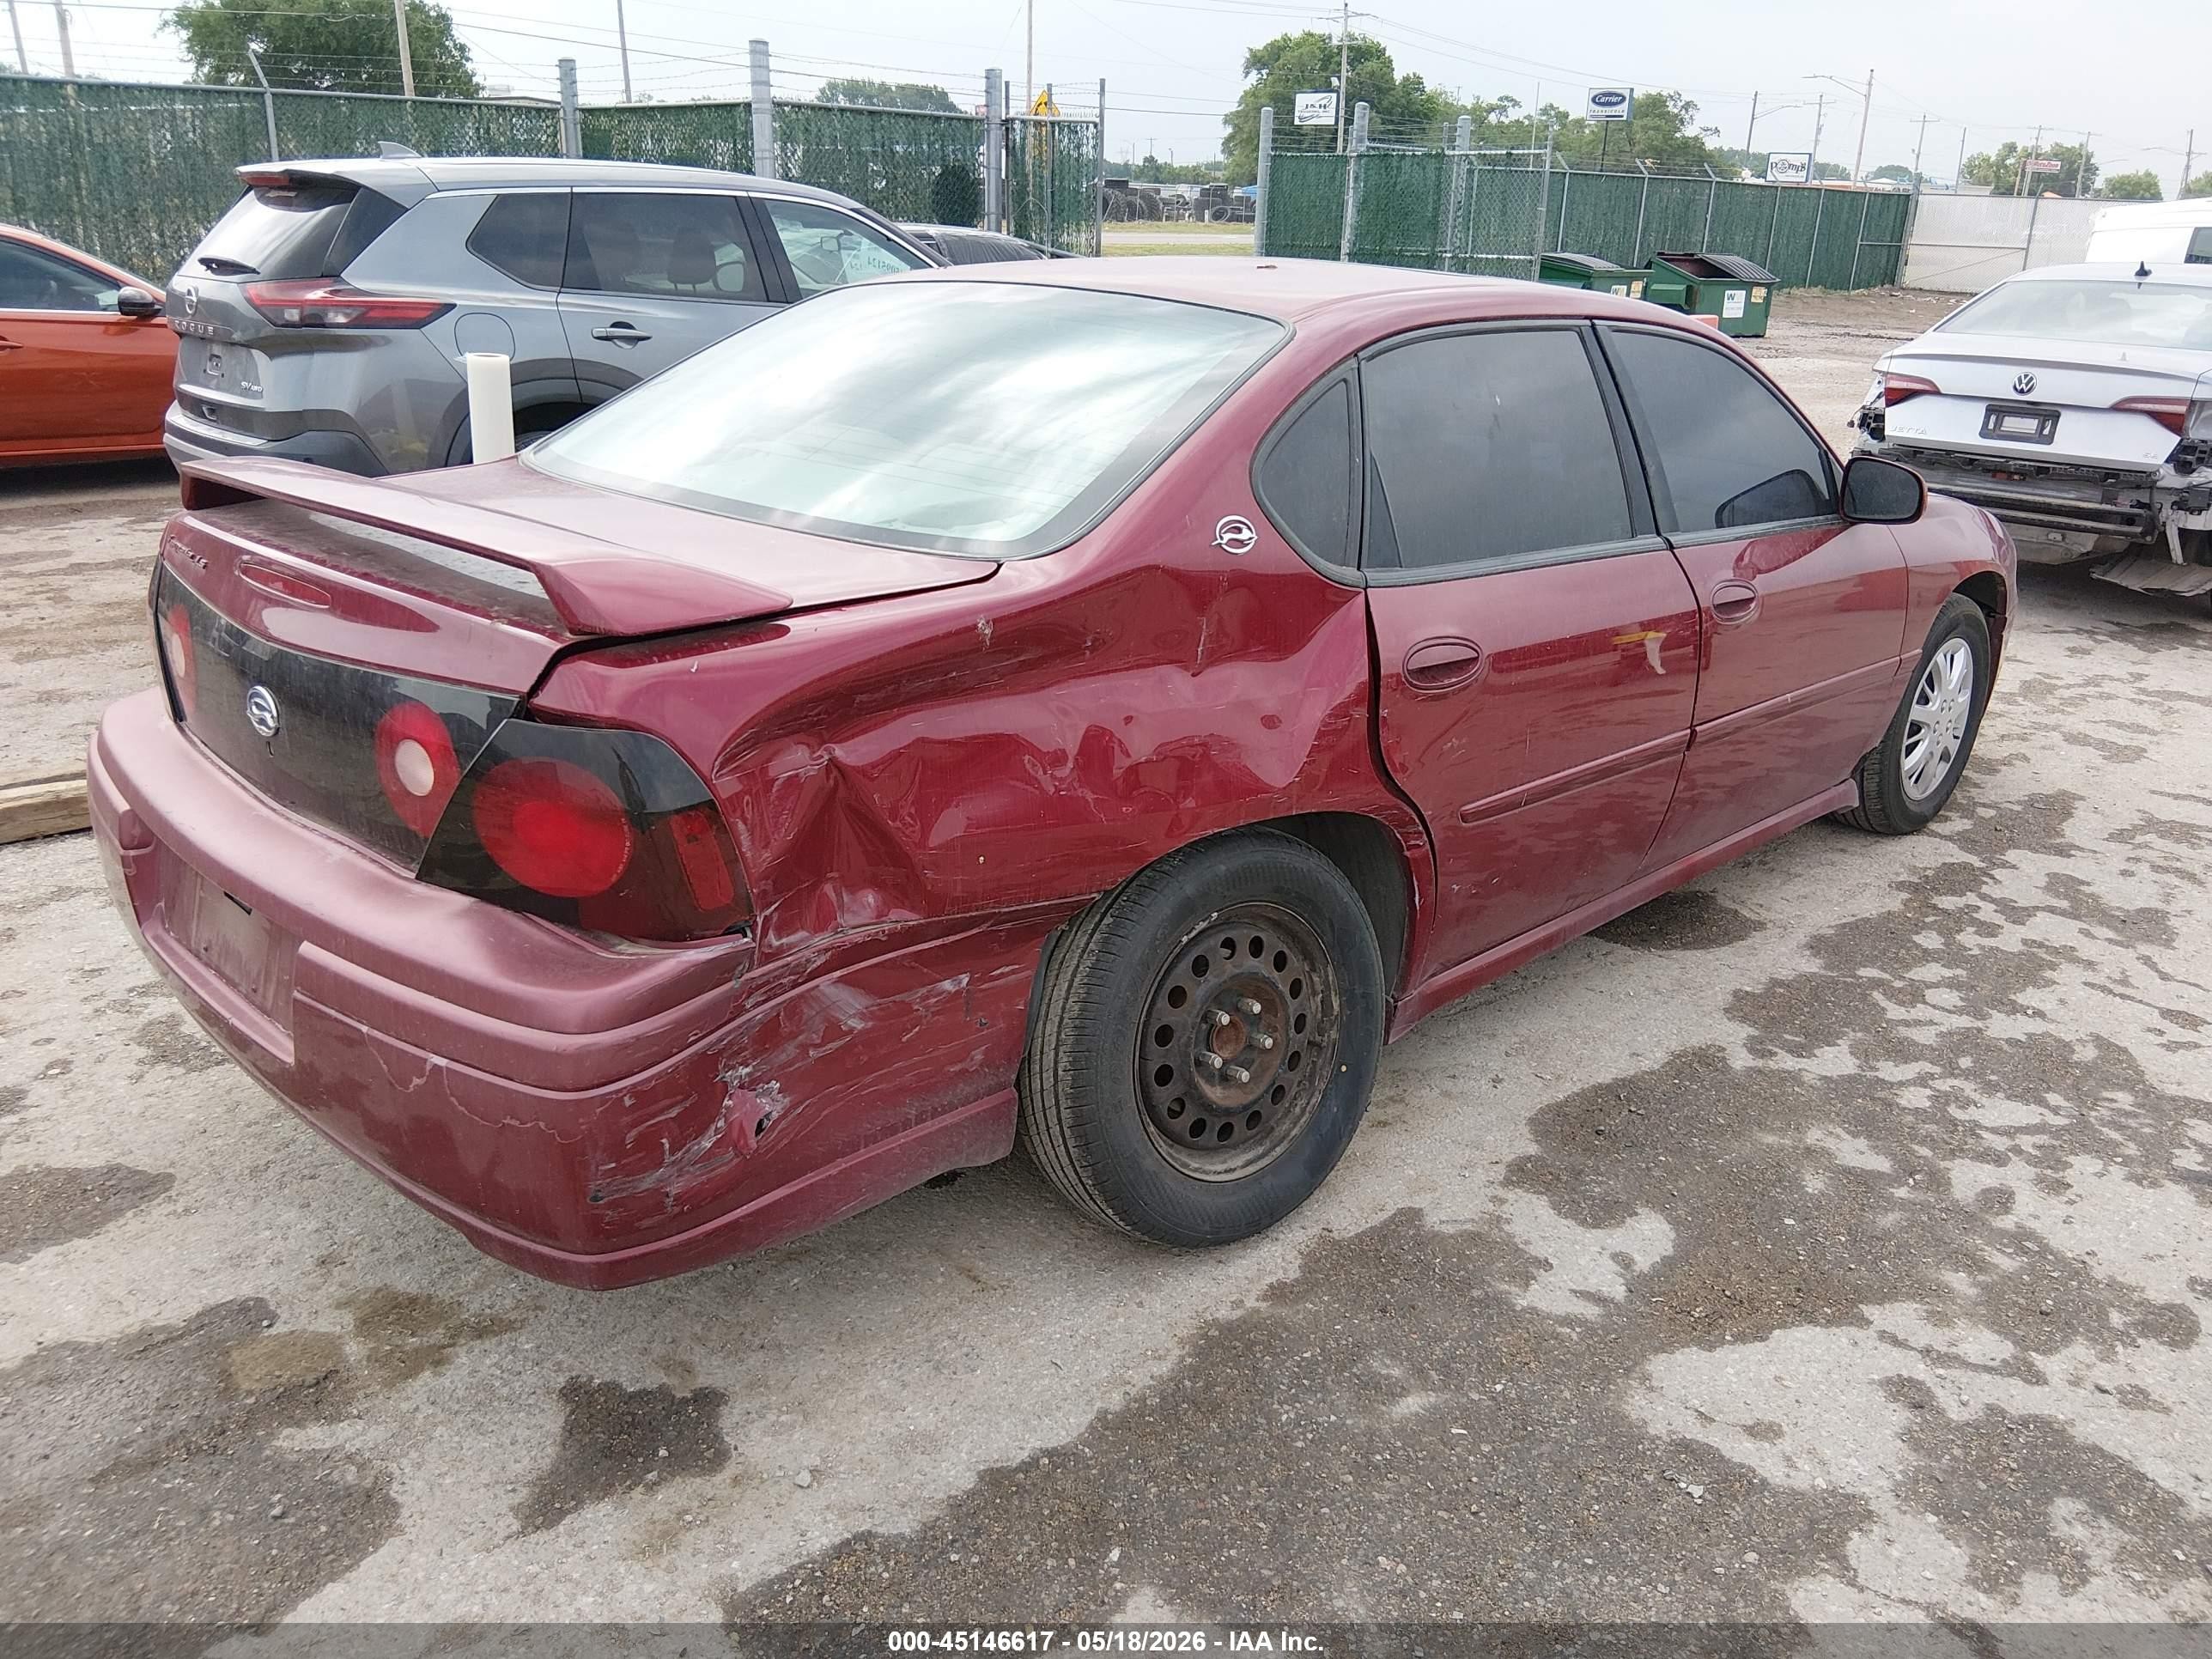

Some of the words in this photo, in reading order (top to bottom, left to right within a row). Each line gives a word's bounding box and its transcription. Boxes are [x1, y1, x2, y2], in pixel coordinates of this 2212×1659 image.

[1595, 94, 1623, 104] Carrier
[174, 319, 214, 335] ROGUE
[240, 381, 252, 391] SV
[1889, 424, 1927, 435] JETTA
